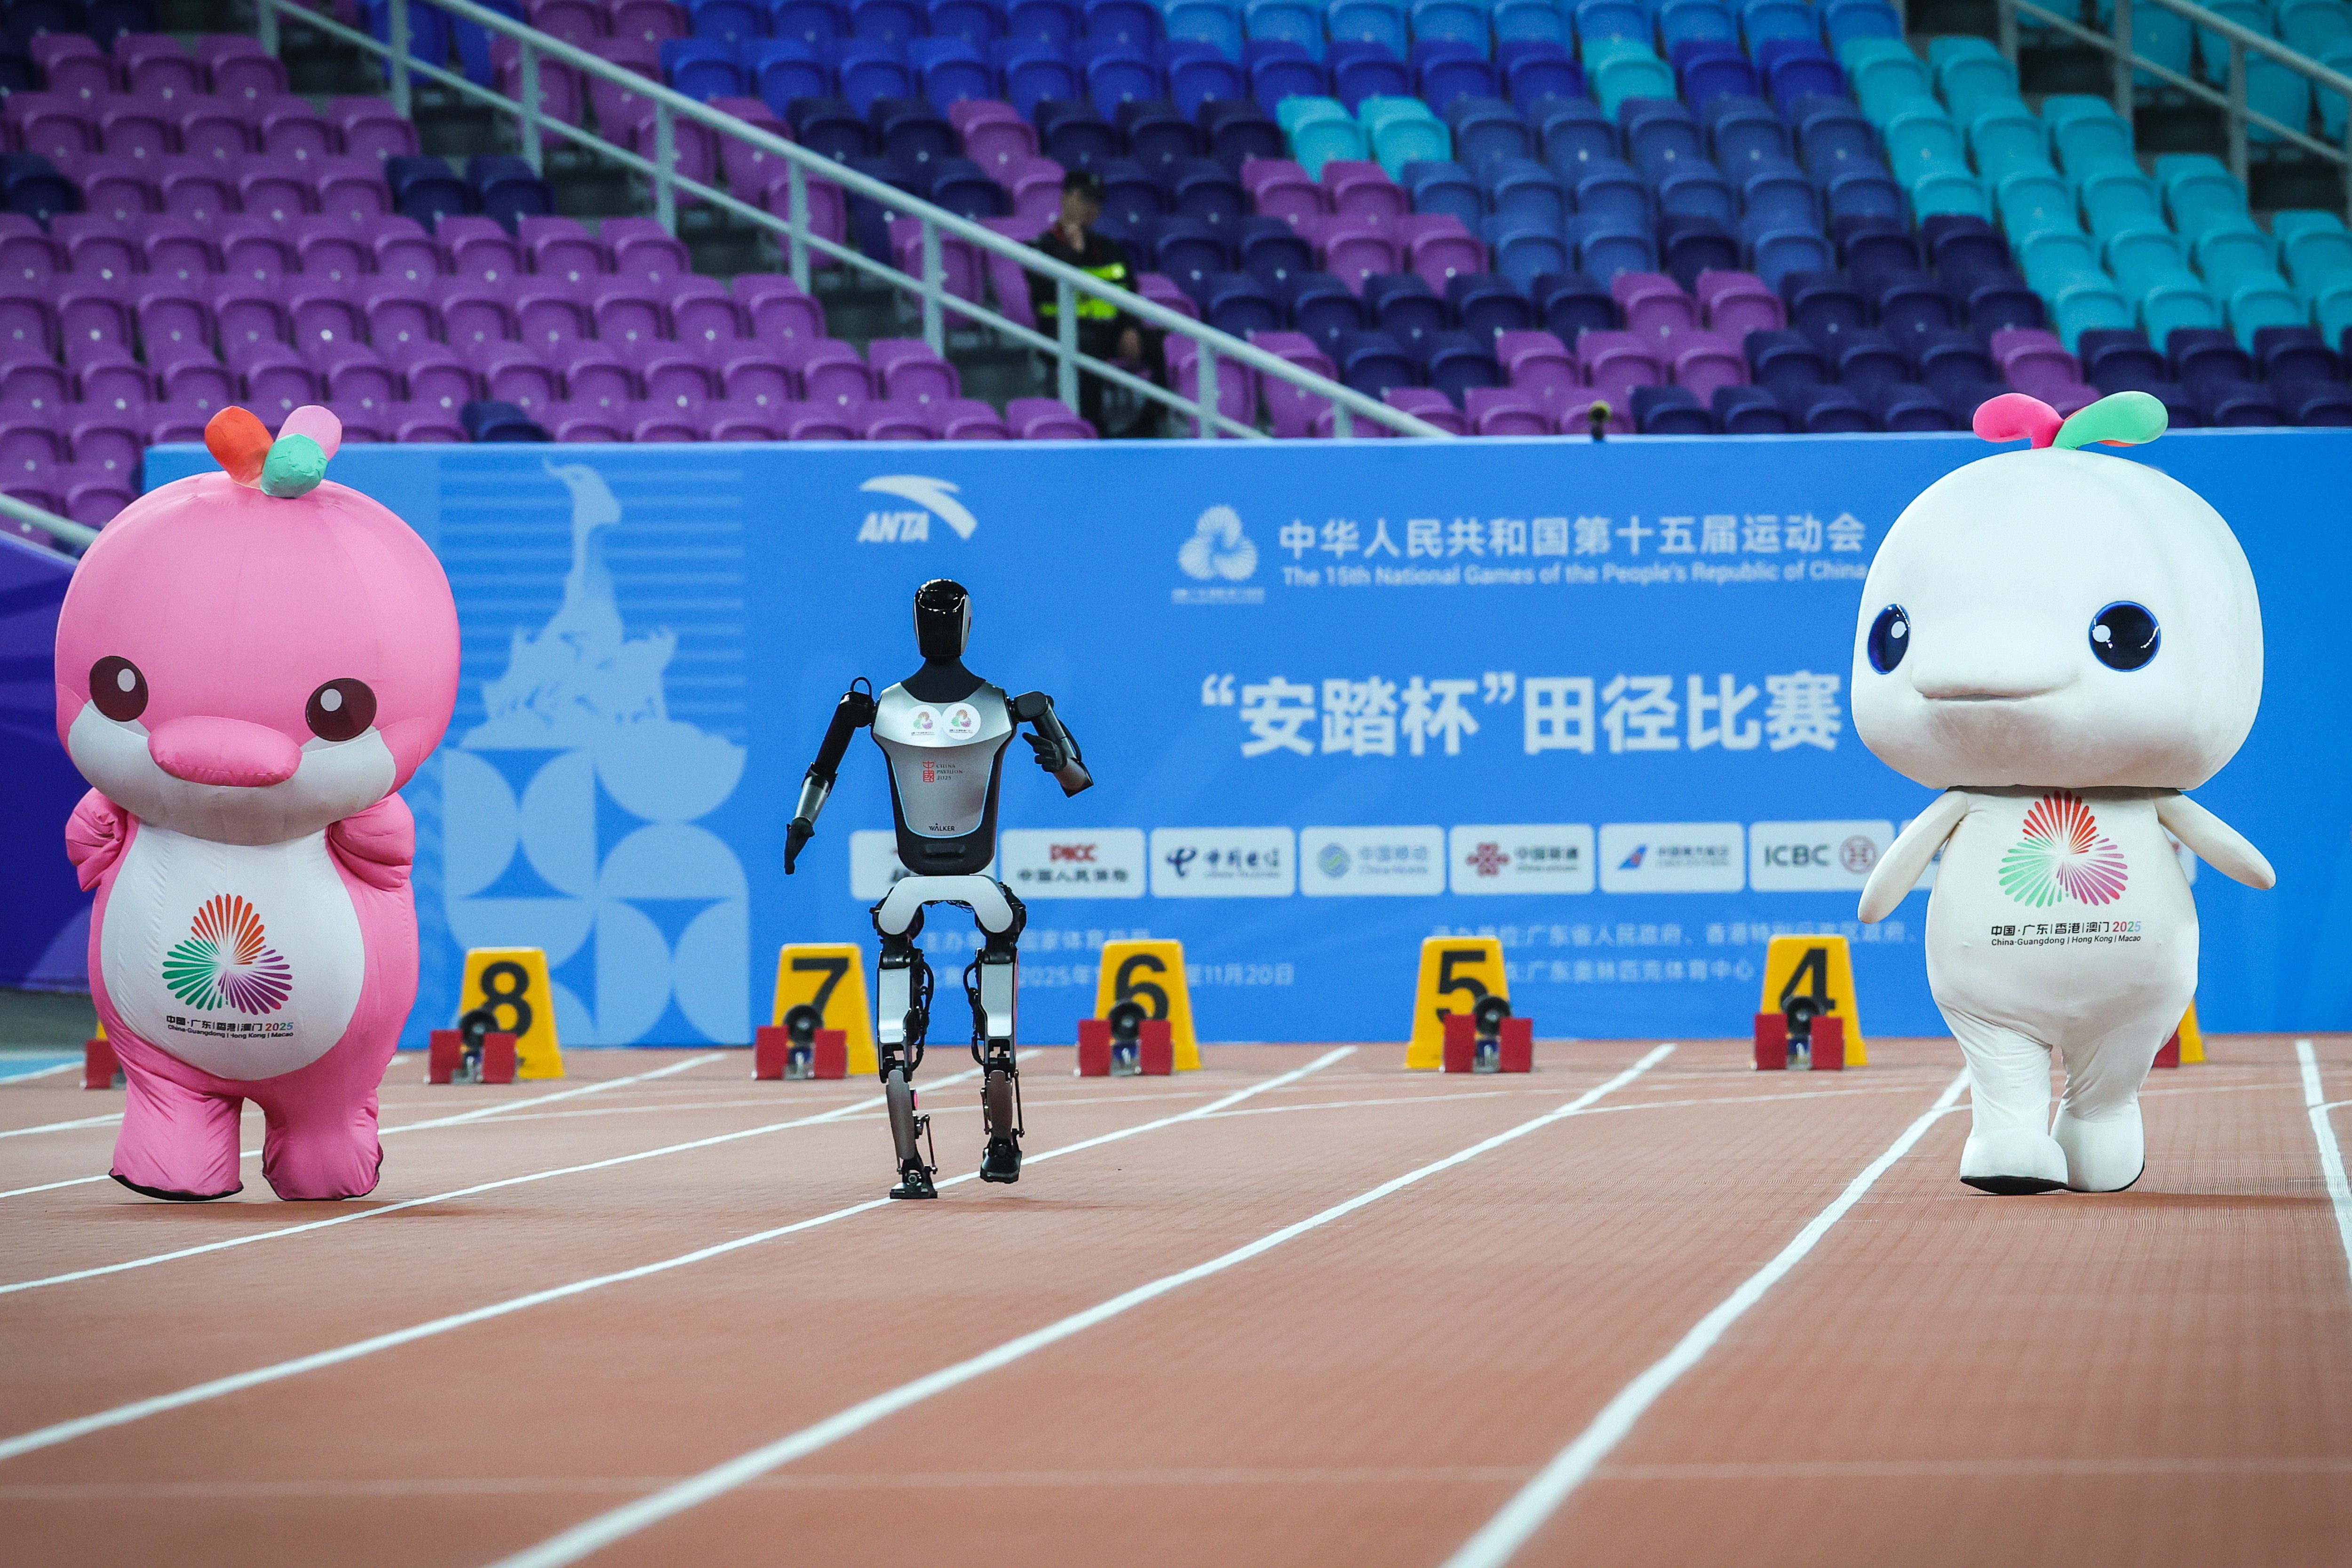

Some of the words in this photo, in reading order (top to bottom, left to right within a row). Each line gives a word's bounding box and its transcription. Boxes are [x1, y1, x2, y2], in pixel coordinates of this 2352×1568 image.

[857, 512, 930, 542] ANTA
[1279, 513, 1866, 559] 中华人民共和国第十五届运动会
[1282, 566, 1320, 586] The
[1375, 564, 1461, 585] National
[1464, 564, 1535, 585] Games
[1538, 562, 1560, 584] of
[1692, 561, 1780, 586] Republic
[1783, 559, 1804, 581] of
[1809, 559, 1868, 581] China
[1764, 844, 1830, 867] ICBC
[2072, 936, 2092, 945] Hong
[2094, 935, 2113, 944] Kong
[2118, 934, 2141, 942] Macao
[2112, 921, 2142, 933] 2025
[481, 960, 532, 1038] 8
[792, 956, 850, 1016] 7
[1115, 953, 1169, 1021] 6
[1436, 949, 1487, 1024] 5
[1780, 947, 1836, 1014] 4
